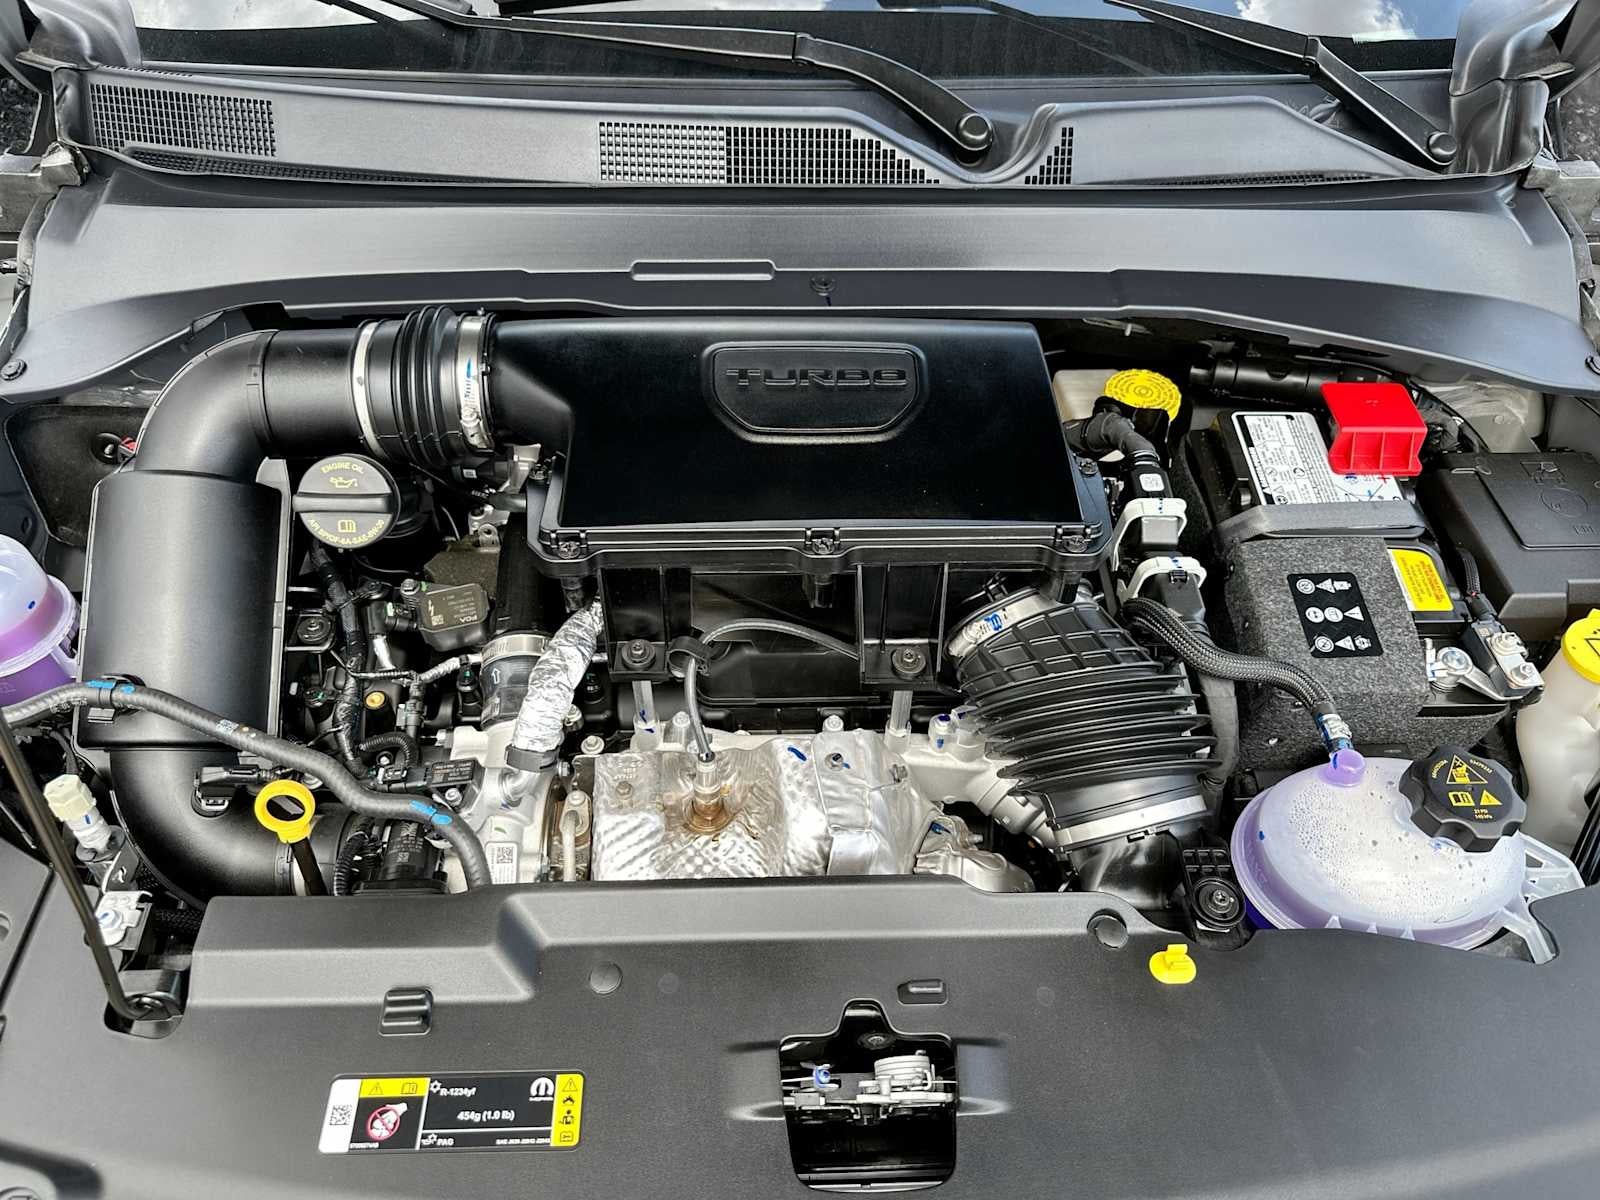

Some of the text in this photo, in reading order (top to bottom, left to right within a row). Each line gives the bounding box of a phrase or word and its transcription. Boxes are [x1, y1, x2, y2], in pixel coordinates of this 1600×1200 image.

[726, 368, 907, 387] TURBO
[320, 461, 365, 475] ENGINE OIL
[439, 1086, 477, 1097] R-1234yf
[457, 1110, 482, 1122] 454g
[482, 1110, 501, 1122] (1.0
[436, 1138, 454, 1146] PAG
